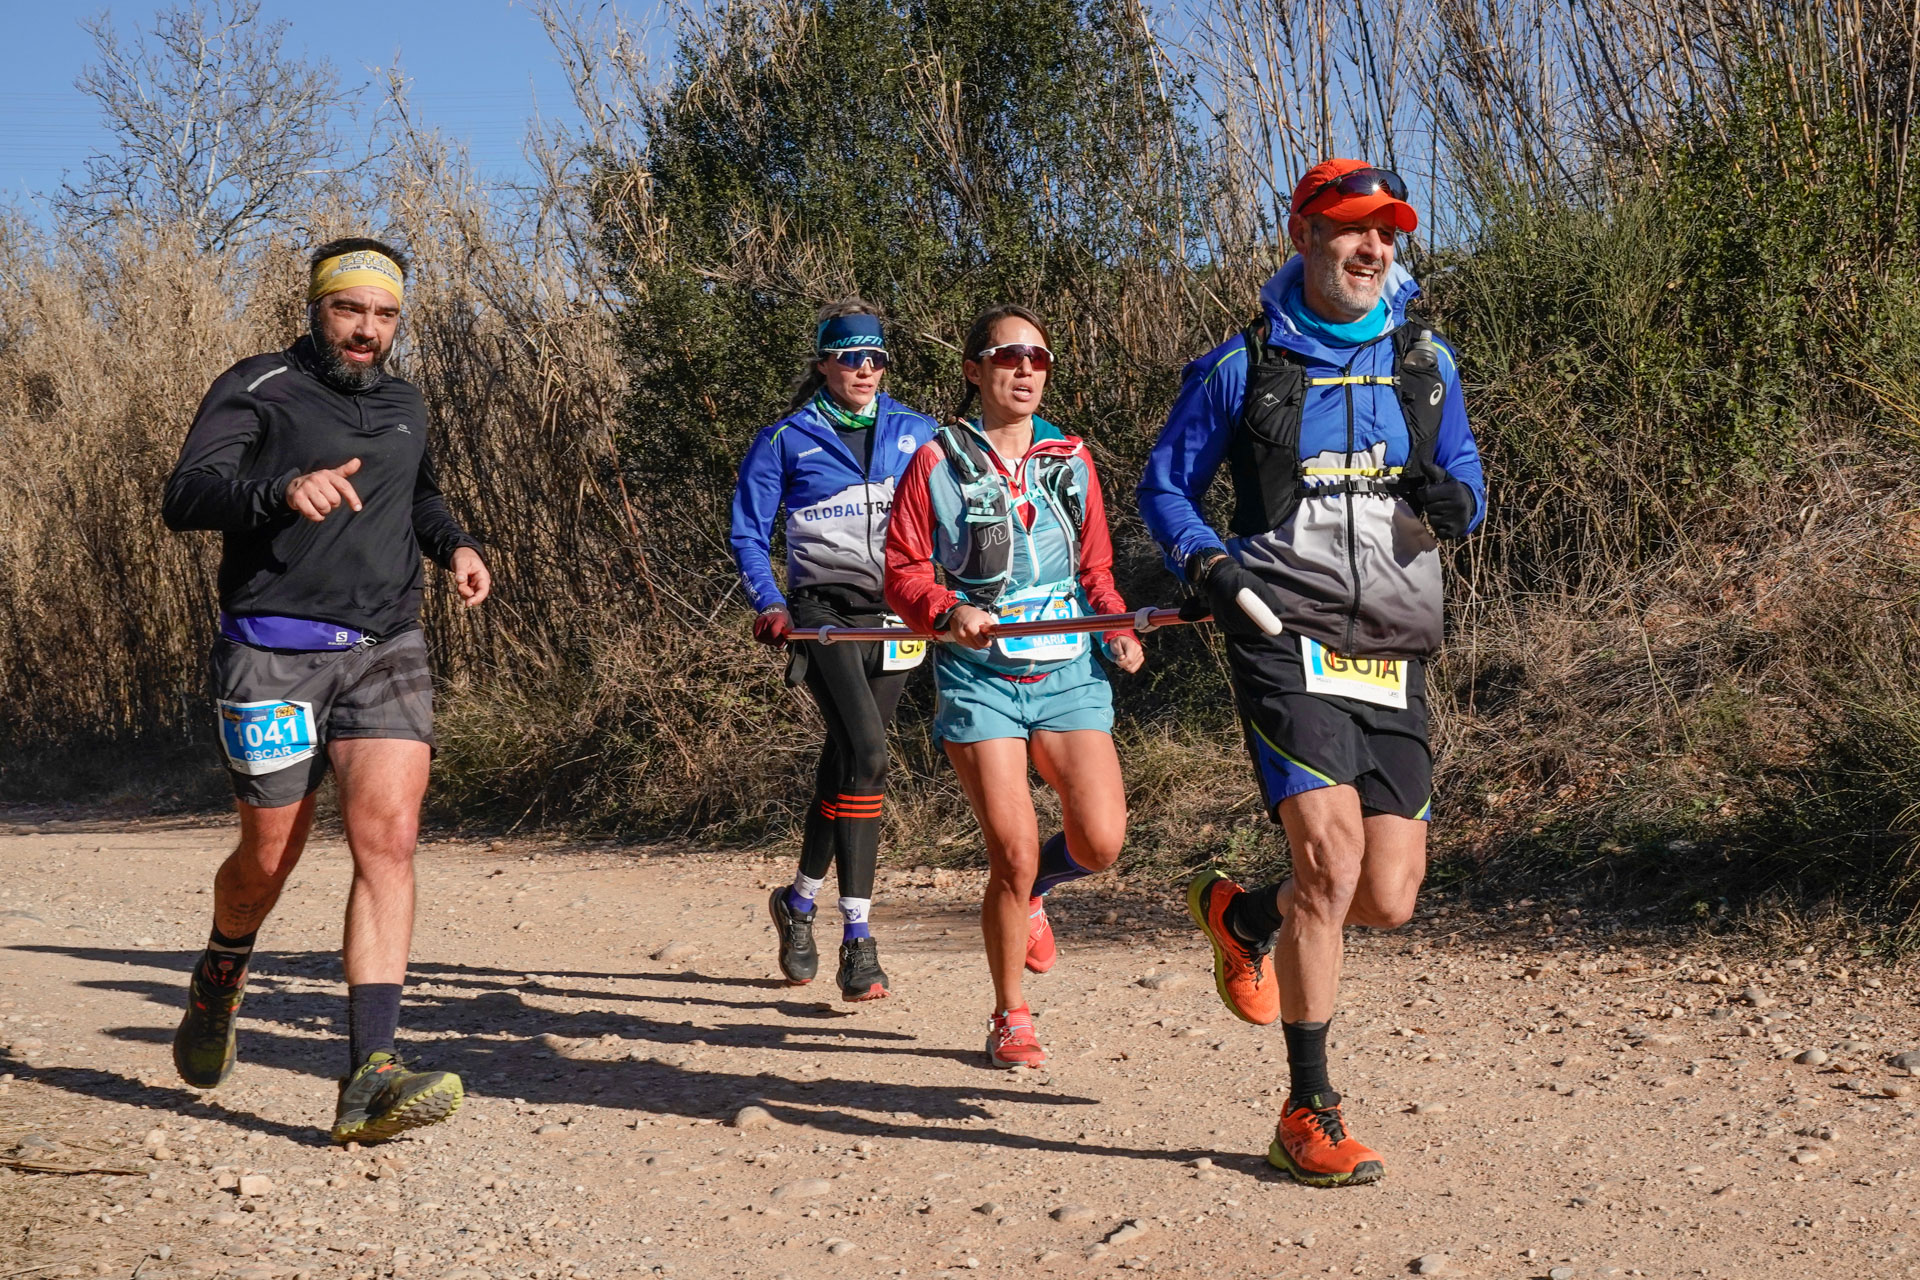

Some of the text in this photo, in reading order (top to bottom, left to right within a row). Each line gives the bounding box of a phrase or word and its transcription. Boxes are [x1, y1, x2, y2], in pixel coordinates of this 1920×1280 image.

[1032, 632, 1067, 647] MARIA
[234, 717, 299, 748] 1041
[244, 746, 293, 761] OSCAR
